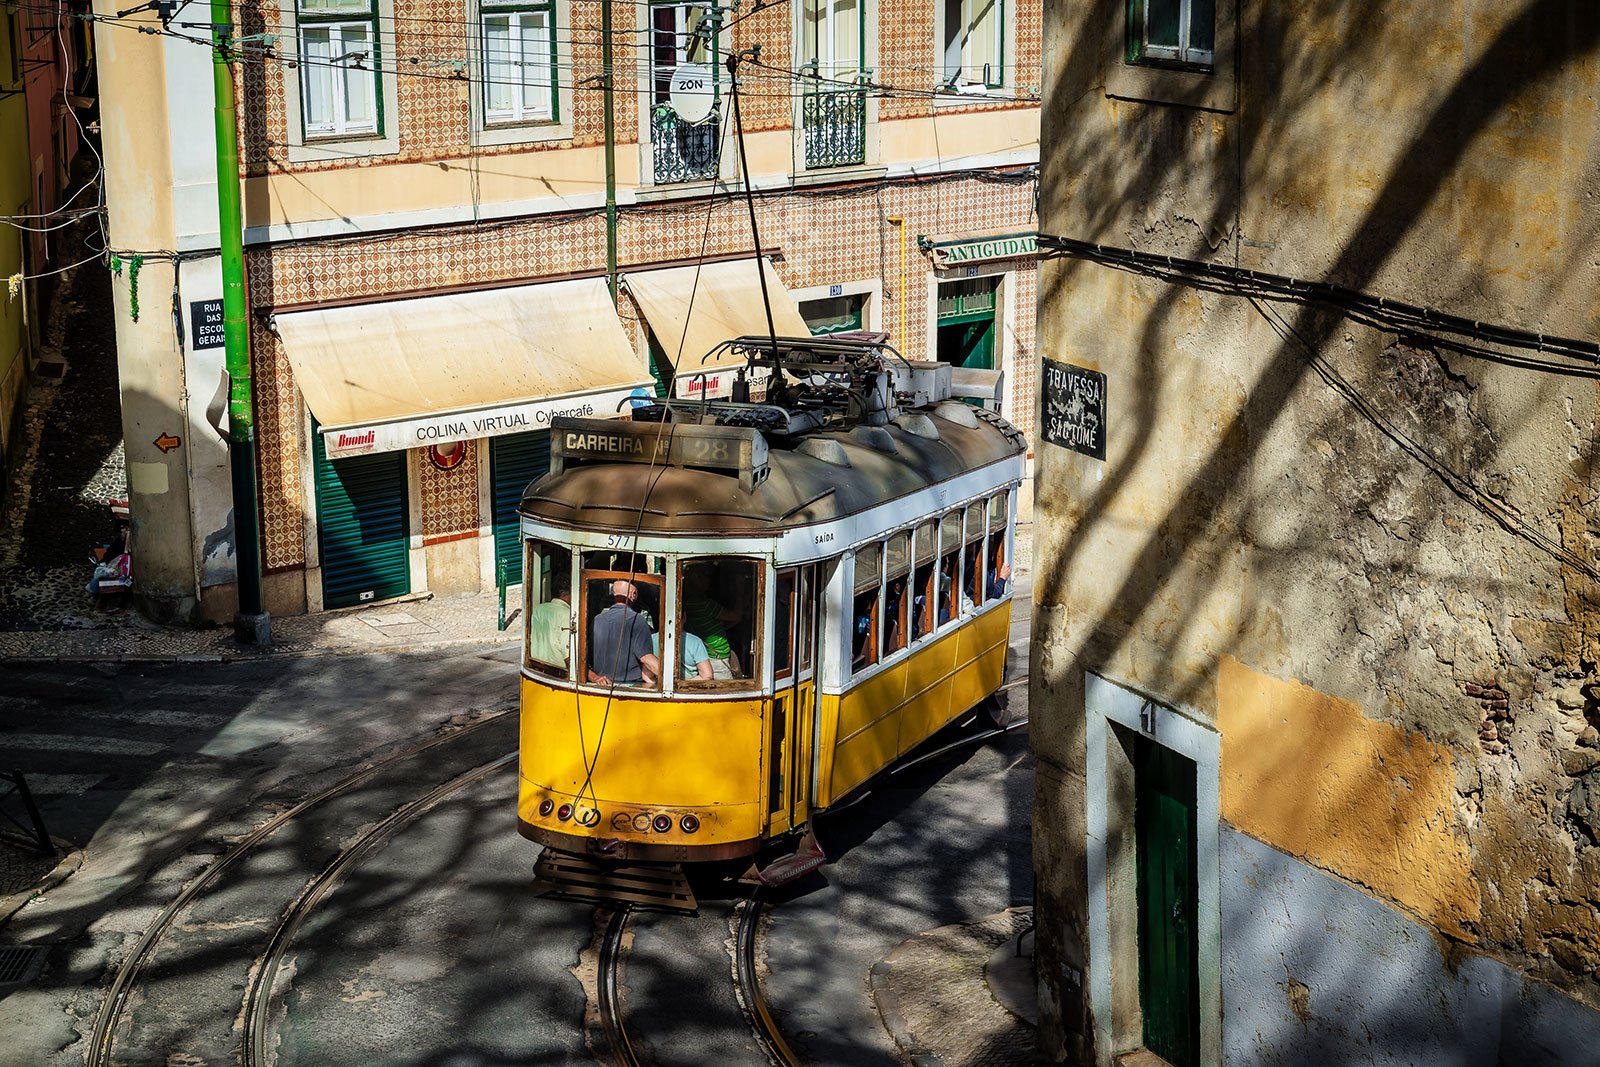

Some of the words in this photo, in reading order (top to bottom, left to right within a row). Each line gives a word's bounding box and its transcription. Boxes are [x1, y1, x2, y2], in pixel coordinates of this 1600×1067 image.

[679, 79, 703, 91] ZON
[948, 238, 1038, 262] ANTIGUIDAD
[204, 303, 222, 312] RUA
[206, 314, 222, 323] DAS
[416, 422, 468, 440] COLINA
[473, 413, 530, 432] VIRTUAL
[535, 404, 594, 424] Cybercafé
[566, 433, 643, 454] CARREIRA
[695, 440, 728, 460] 28
[608, 534, 630, 548] 577
[815, 532, 834, 544] SAÍDA
[1142, 702, 1152, 733] 1
